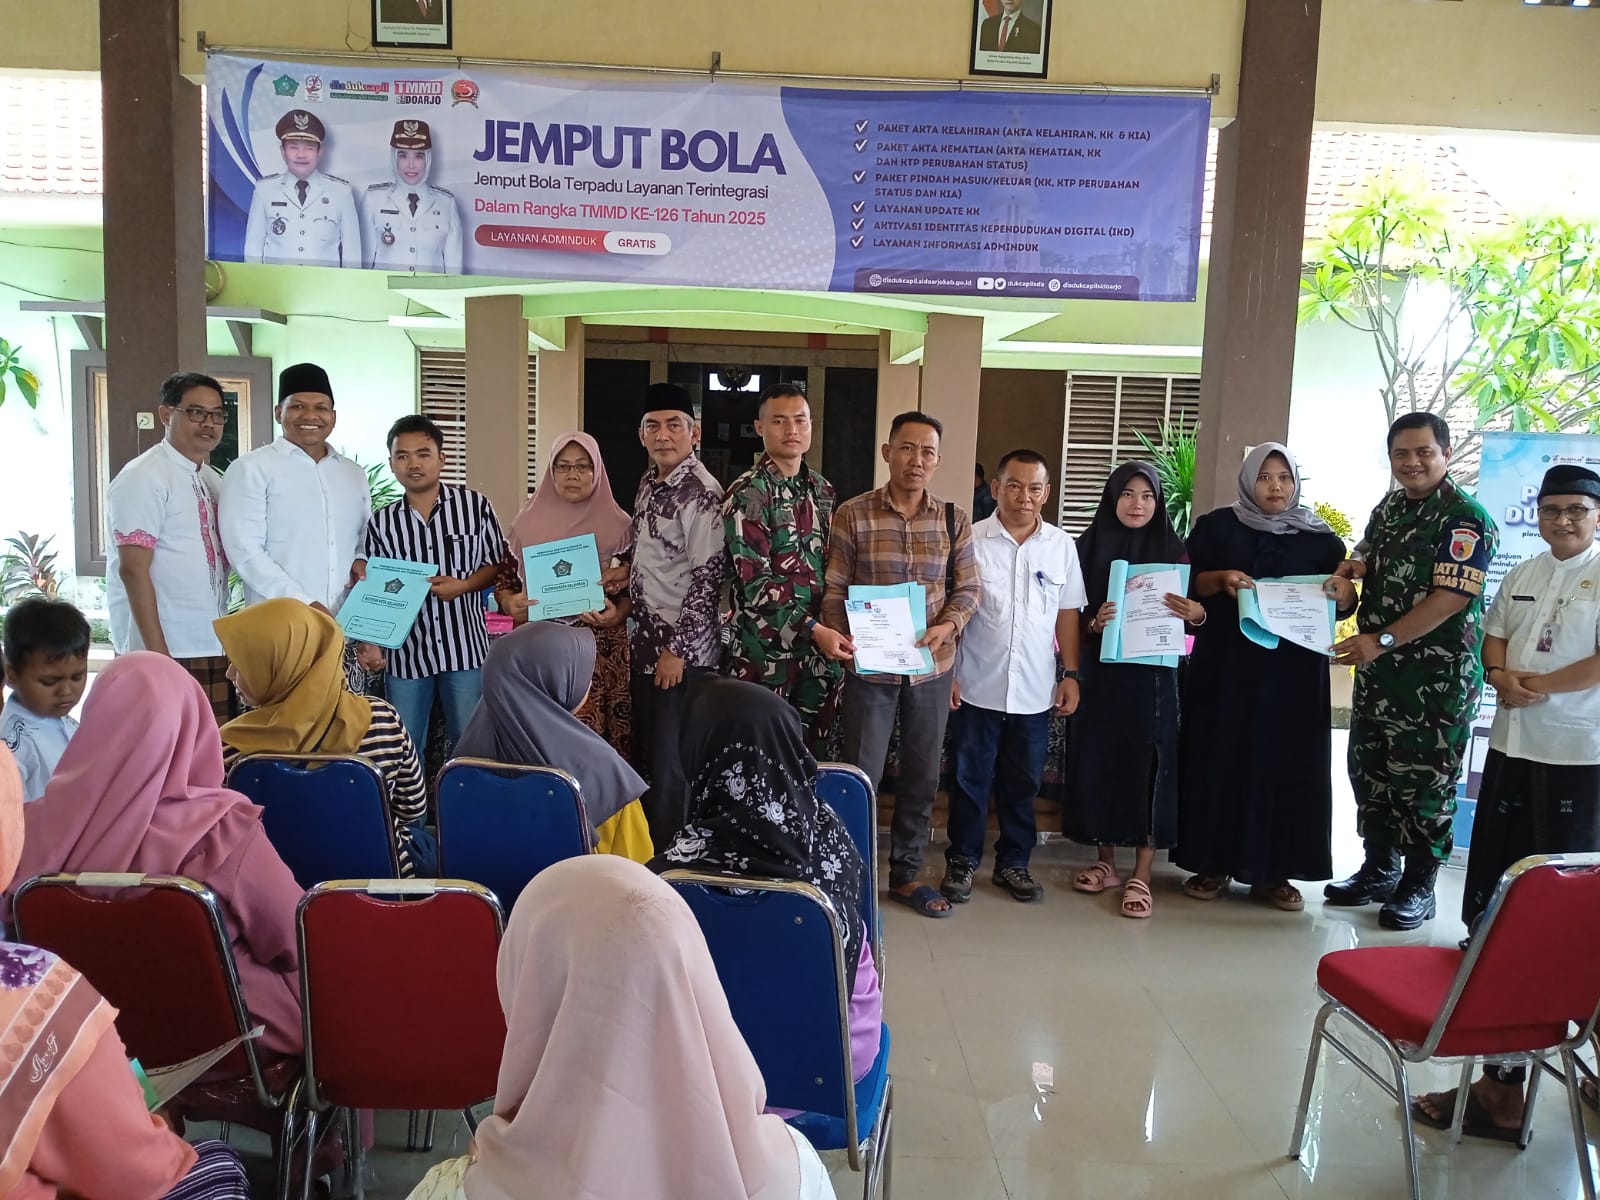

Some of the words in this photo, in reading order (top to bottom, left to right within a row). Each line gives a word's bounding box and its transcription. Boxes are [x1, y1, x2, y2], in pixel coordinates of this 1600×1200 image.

[396, 82, 442, 94] TMMD
[878, 124, 910, 134] PAKET
[912, 124, 938, 134] AKTA
[942, 126, 1000, 136] KELAHIRAN
[1002, 126, 1032, 138] (AKTA
[1036, 128, 1097, 140] KELAHIRAN,
[1100, 130, 1114, 140] KK
[1118, 130, 1126, 140] &
[1128, 130, 1150, 141] KIA)
[473, 119, 651, 169] JEMPUT
[661, 128, 786, 175] BOLA
[877, 142, 910, 152] PAKET
[912, 144, 938, 153] AKTA
[941, 144, 994, 154] KEMATIAN
[996, 145, 1026, 156] (AKTA
[1029, 147, 1084, 158] KEMATIAN,
[1088, 149, 1102, 158] KK
[876, 157, 898, 166] DAN
[900, 158, 920, 167] KTP
[922, 158, 984, 168] PERUBAHAN
[986, 160, 1028, 171] STATUS)
[474, 172, 526, 190] Jemput
[530, 175, 561, 190] Bola
[564, 177, 623, 194] Terpadu
[627, 180, 683, 199] Layanan
[686, 182, 768, 201] Terintegrasi
[876, 173, 908, 182] PAKET
[910, 174, 950, 184] PINDAH
[952, 175, 1032, 186] MASUK/KELUAR
[1057, 178, 1076, 188] KTP
[1078, 179, 1140, 189] PERUBAHAN
[875, 188, 912, 197] STATUS
[916, 189, 936, 198] DAN
[940, 189, 962, 200] KIA)
[474, 199, 520, 215] Dalam
[524, 202, 577, 220] Rangka
[580, 204, 628, 220] TMMD
[630, 206, 679, 222] KE-126
[682, 208, 725, 224] Tahun
[728, 210, 766, 226] 2025
[874, 204, 922, 214] LAYANAN
[924, 206, 964, 216] UPDATE
[966, 207, 980, 216] KK
[874, 221, 922, 231] AKTIVASI
[924, 222, 978, 232] IDENTITAS
[981, 224, 1062, 235] KEPENDUDUKAN
[1064, 226, 1106, 236] DIGITAL
[1108, 226, 1134, 237] (IKD)
[490, 231, 539, 244] LAYANAN
[541, 234, 597, 246] ADMINDUK
[618, 238, 656, 249] GRATIS
[873, 239, 920, 248] LAYANAN
[923, 240, 982, 250] INFORMASI
[984, 242, 1039, 252] ADMINDUK
